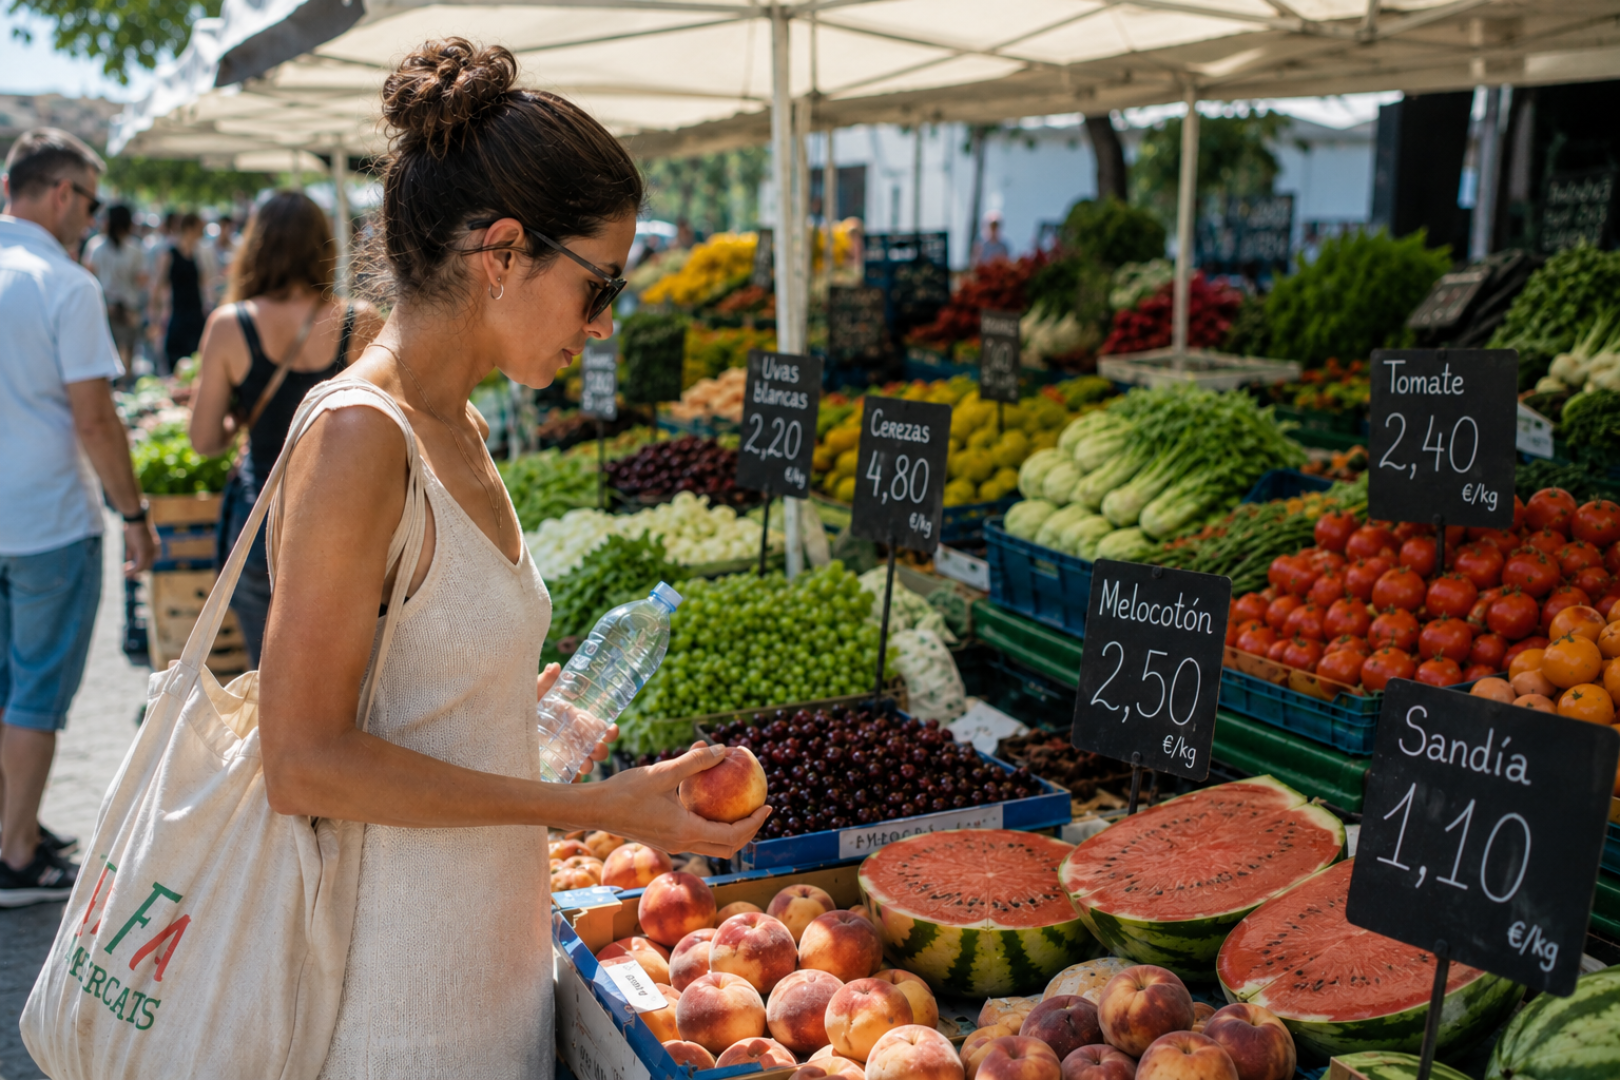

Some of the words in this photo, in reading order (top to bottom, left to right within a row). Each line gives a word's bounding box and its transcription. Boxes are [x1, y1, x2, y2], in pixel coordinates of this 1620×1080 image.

[762, 355, 800, 384] Uvas
[1383, 359, 1465, 396] Tomate
[752, 380, 808, 410] blancas
[743, 412, 803, 461] 2,20
[1378, 412, 1479, 480] 2,40
[865, 450, 930, 505] 4,80
[1462, 482, 1499, 512] €/kg
[908, 512, 933, 539] €/kg
[1099, 578, 1213, 635] Melocotón
[1090, 640, 1201, 726] 2,50
[1162, 734, 1197, 769] €/kg
[1399, 705, 1532, 785] Sandía
[1376, 782, 1532, 903] 1,10
[1507, 920, 1560, 972] €/kg
